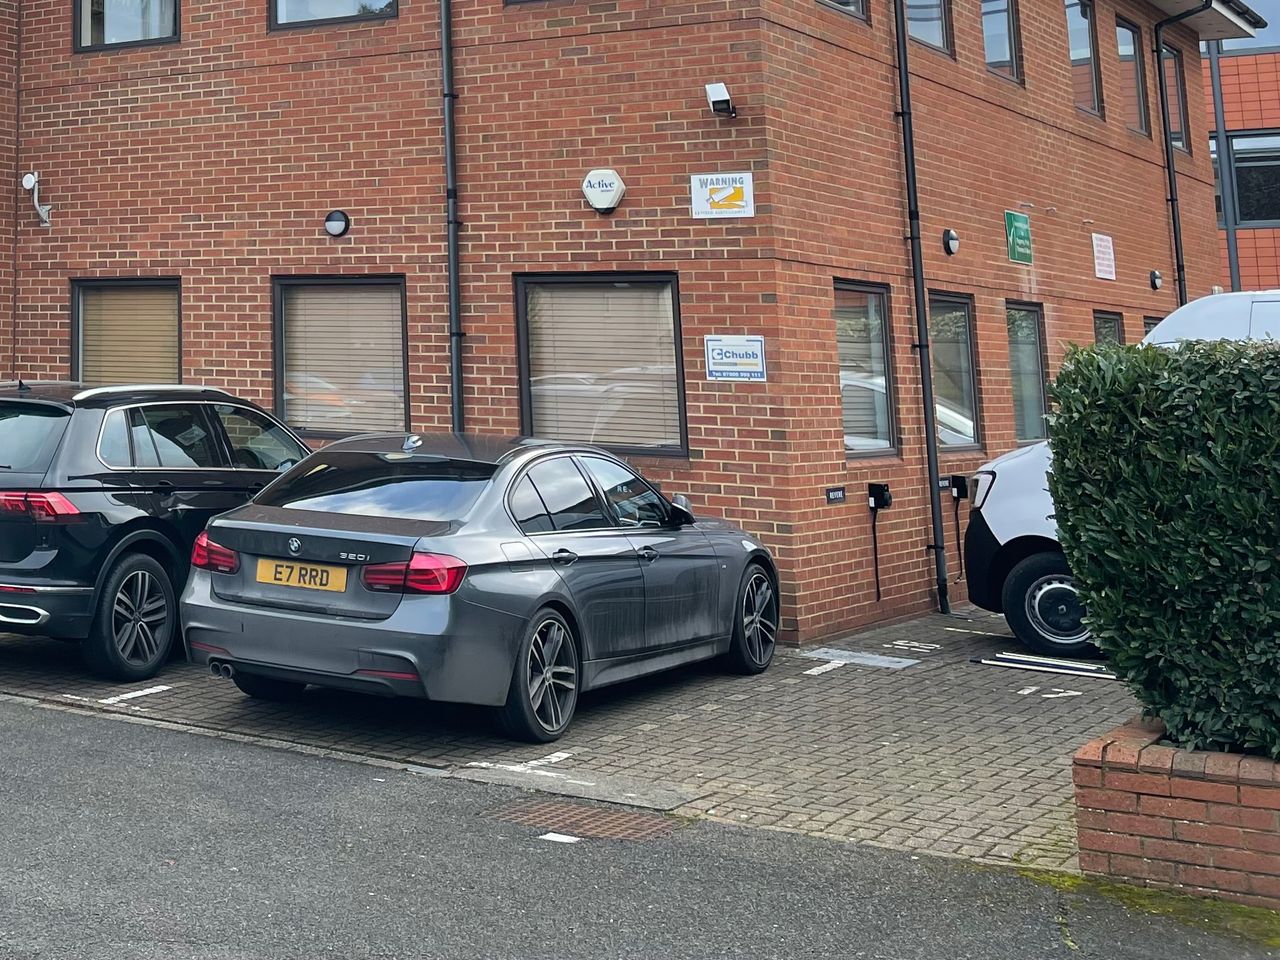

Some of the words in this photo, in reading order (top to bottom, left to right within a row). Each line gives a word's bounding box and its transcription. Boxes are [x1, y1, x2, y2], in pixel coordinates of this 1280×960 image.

[586, 179, 615, 189] Active
[699, 176, 744, 189] WARNING
[724, 351, 759, 359] Chubb
[273, 564, 294, 582] E7
[298, 567, 330, 587] RRD
